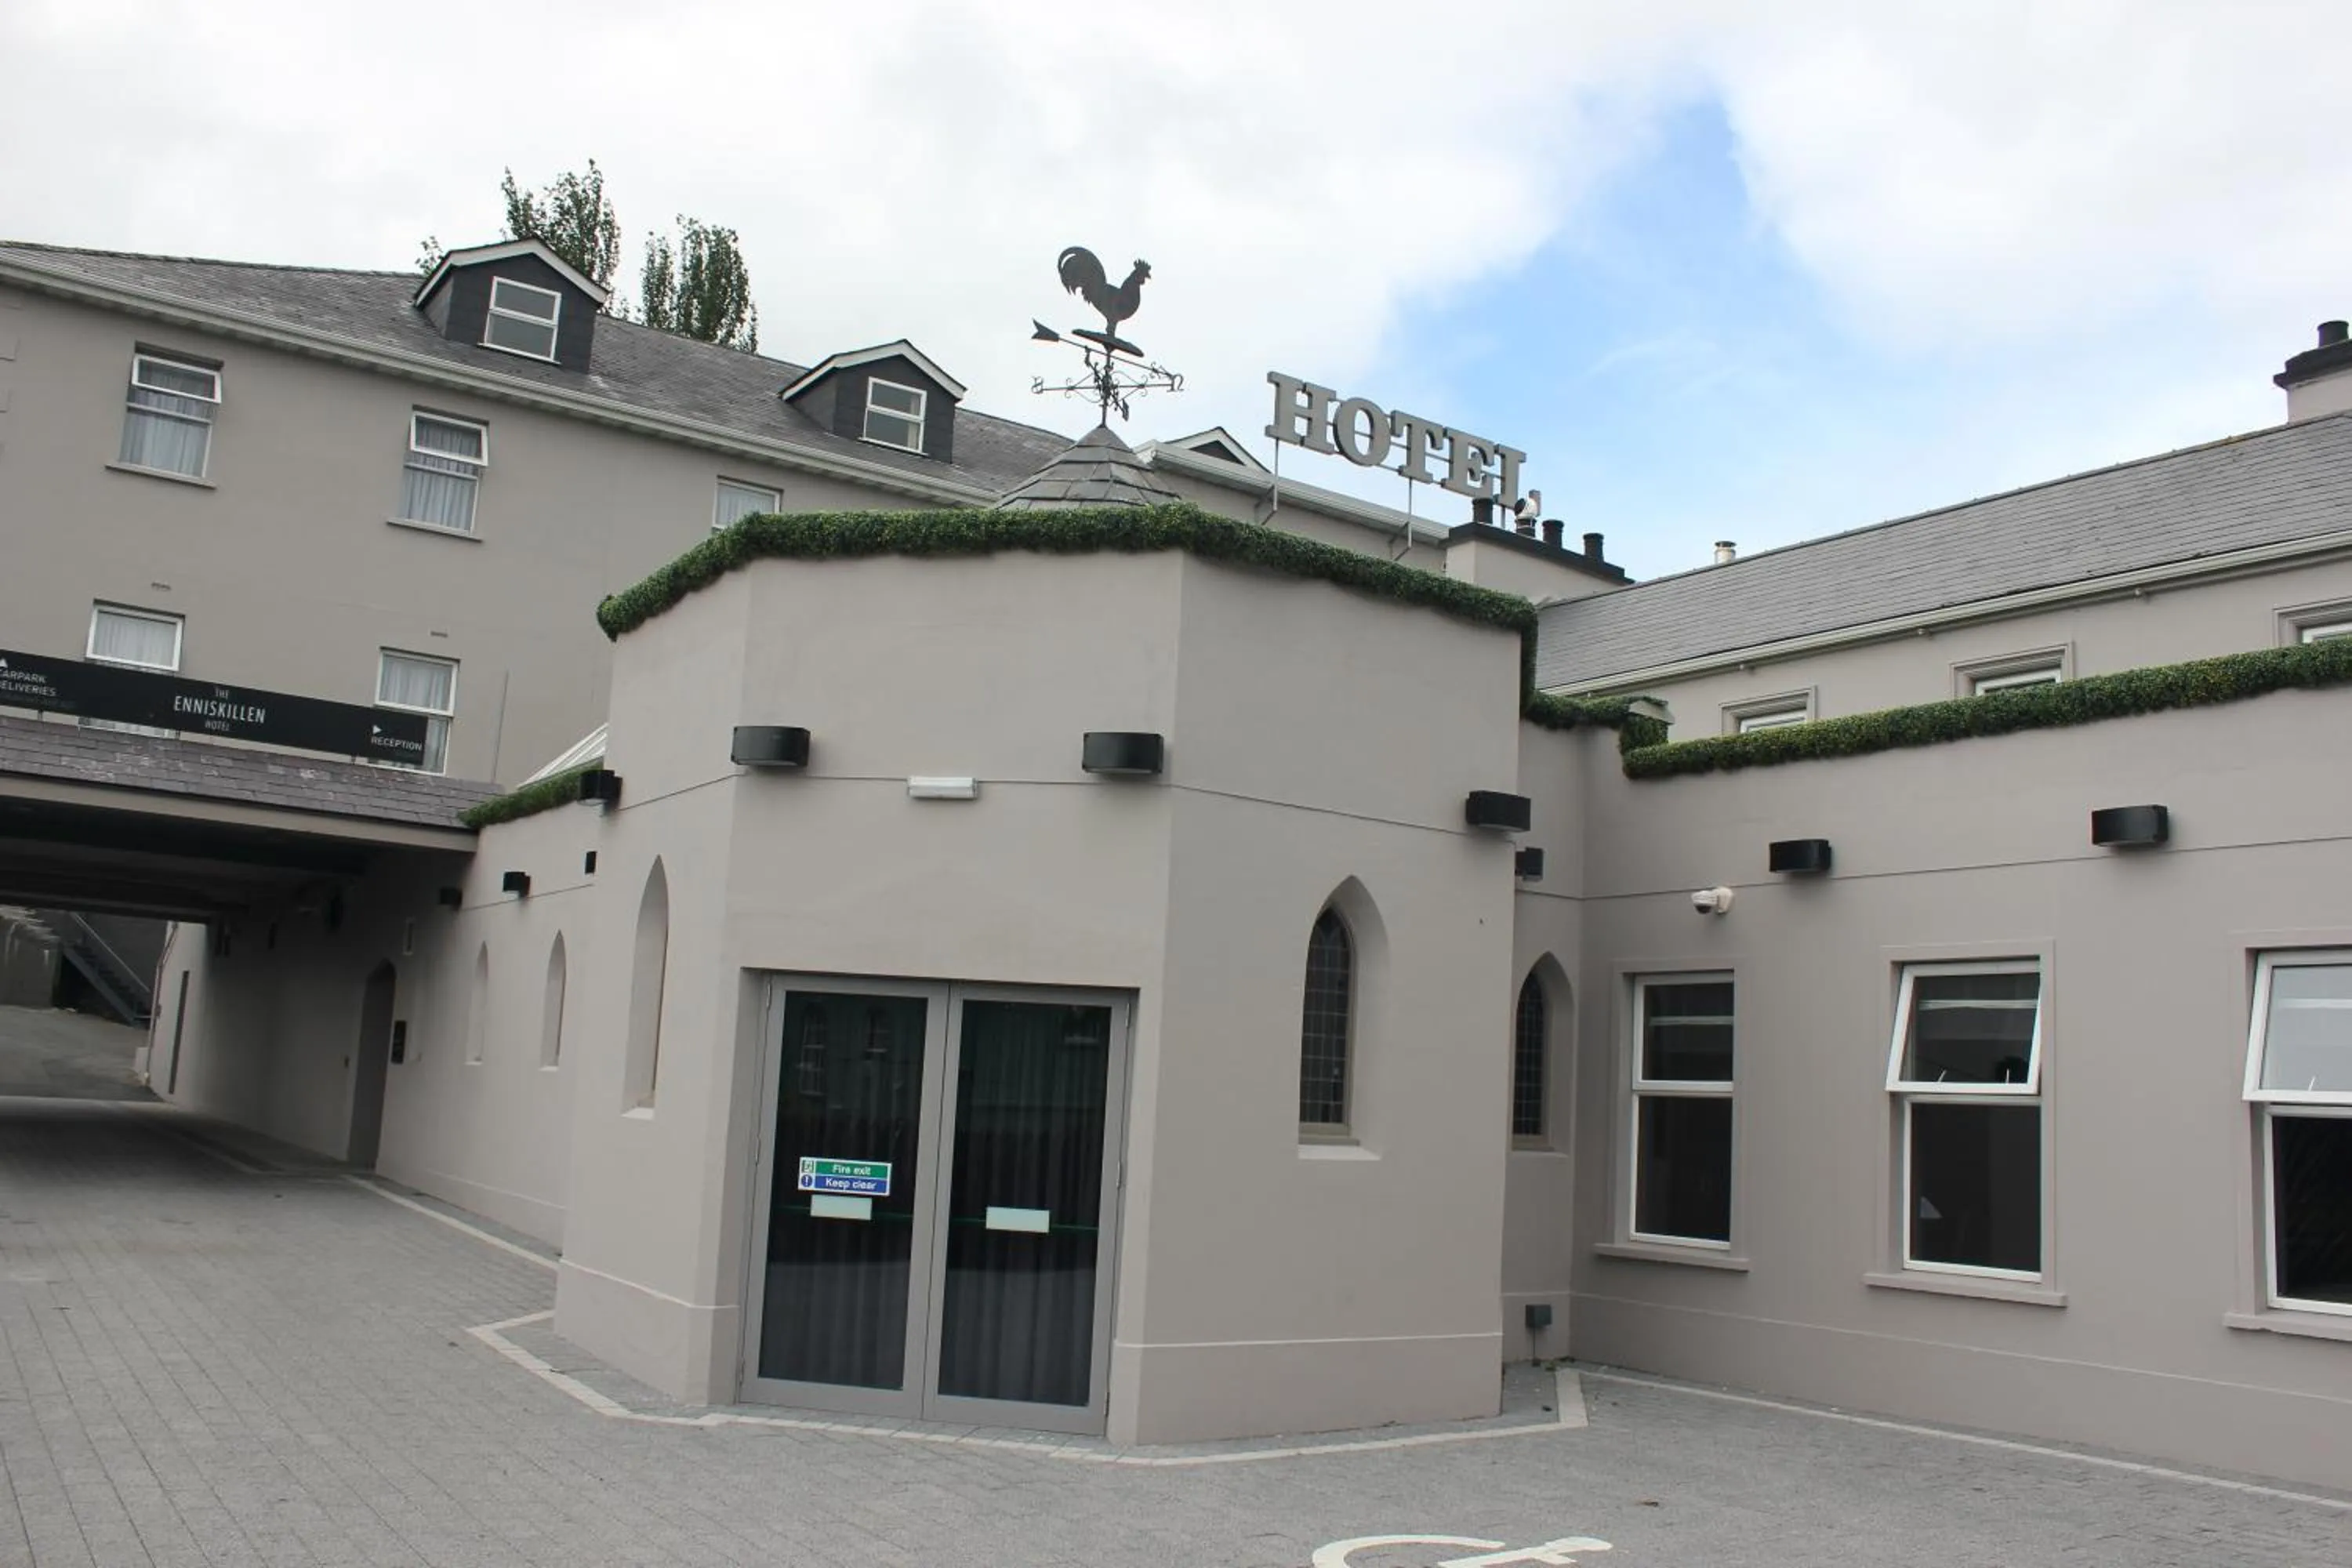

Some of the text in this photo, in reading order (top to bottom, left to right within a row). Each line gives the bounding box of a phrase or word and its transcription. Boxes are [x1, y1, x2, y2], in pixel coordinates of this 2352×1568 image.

[1265, 371, 1541, 517] HOTEL
[0, 668, 47, 684] ARPARK
[0, 680, 57, 697] ELIVERIES
[214, 686, 230, 699] THE
[173, 695, 266, 724] ENNISKILLEN
[205, 718, 230, 731] HOTEL
[371, 735, 423, 750] RECEPTION
[832, 1164, 871, 1175] Fire exit
[826, 1178, 877, 1190] Keep clear
